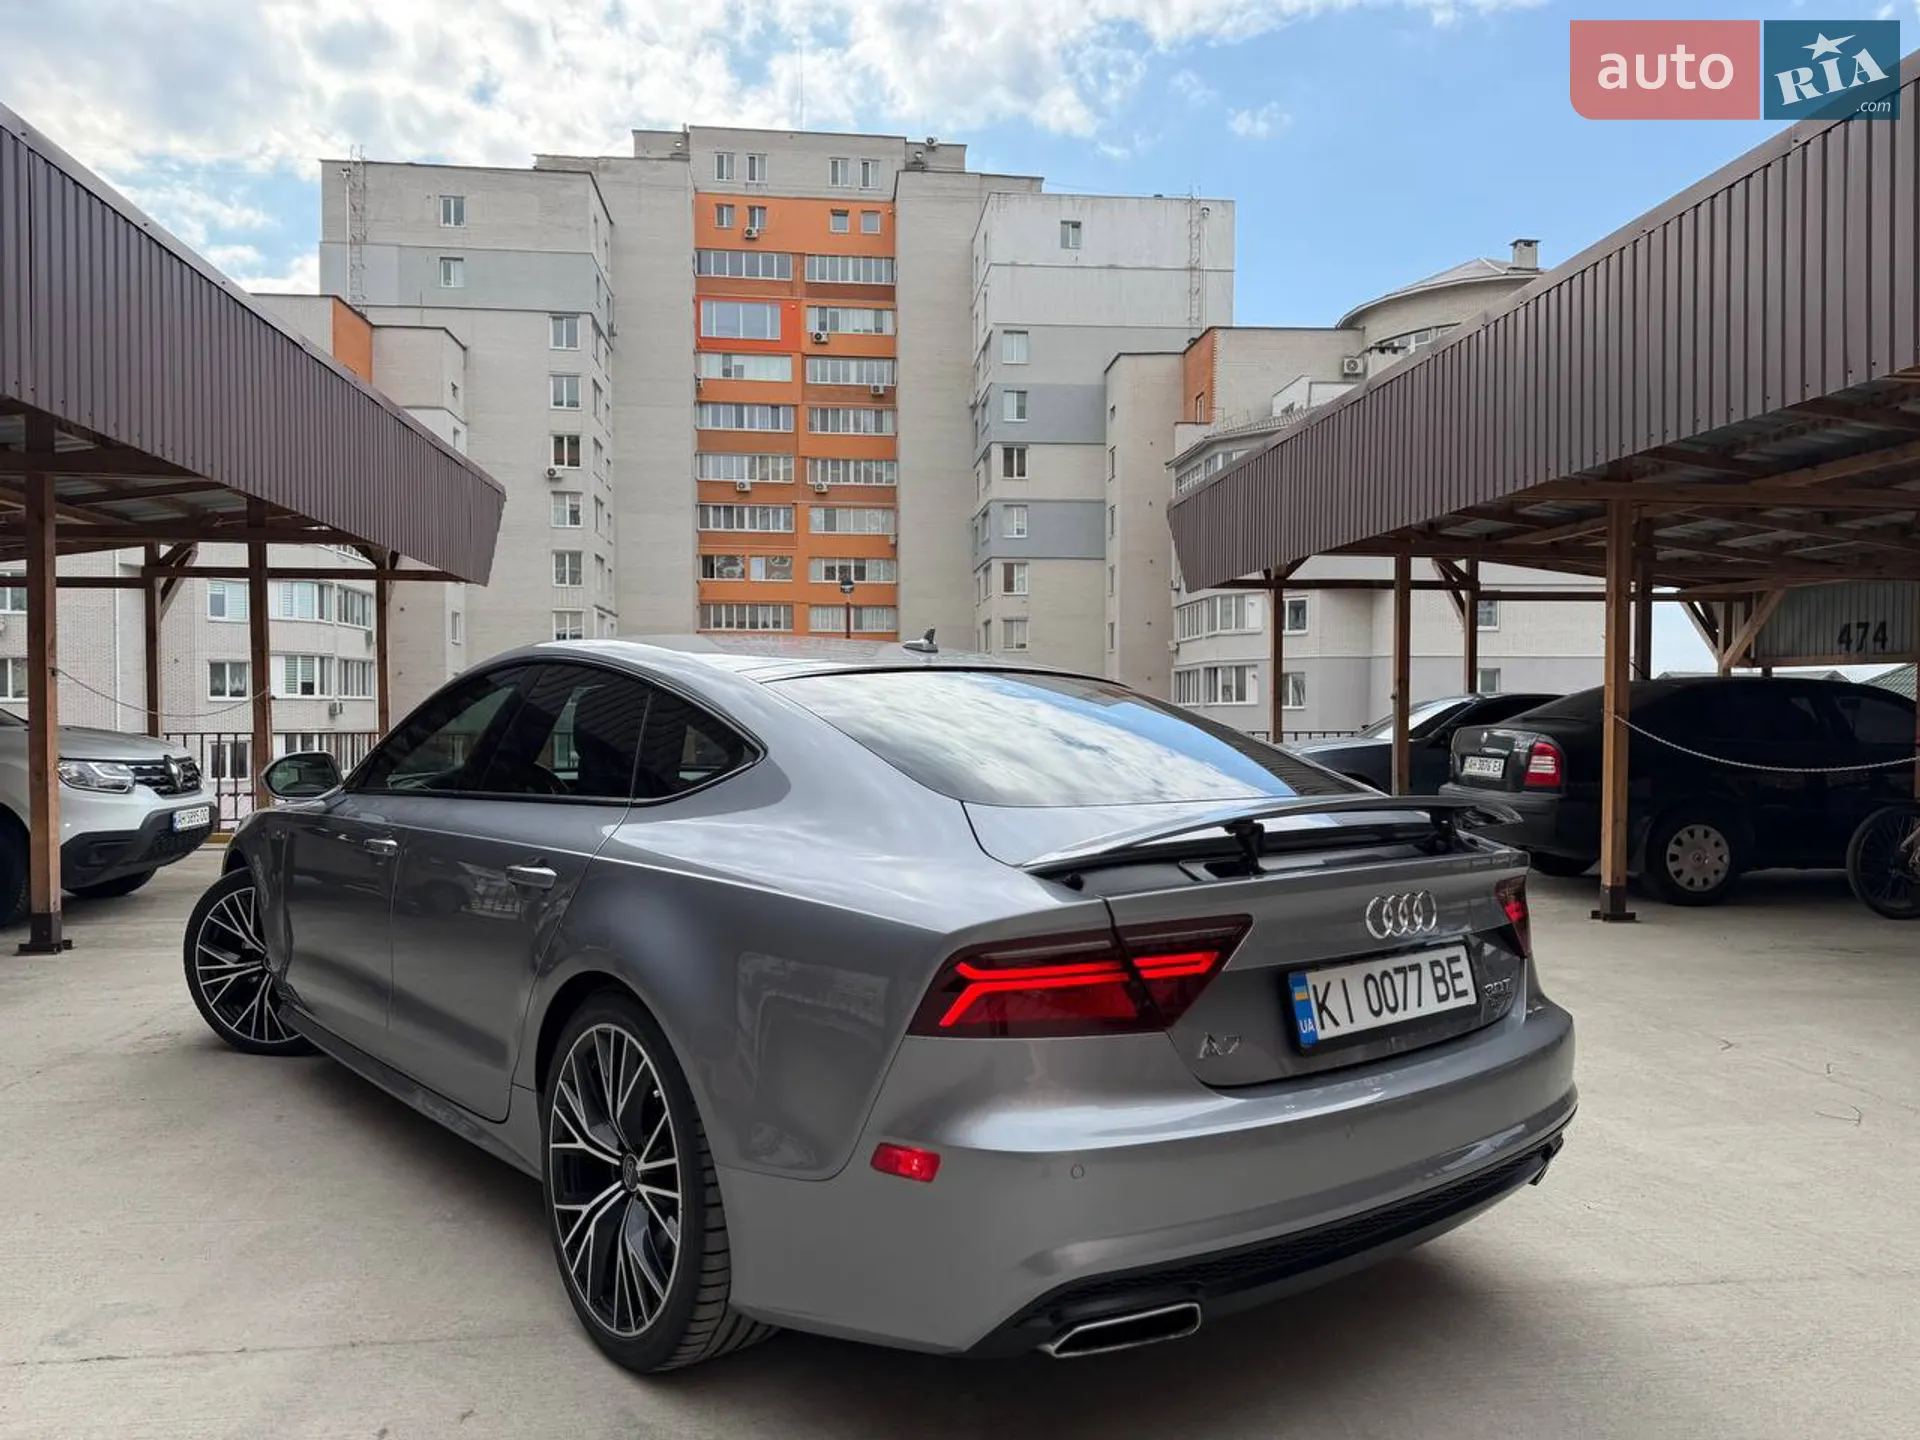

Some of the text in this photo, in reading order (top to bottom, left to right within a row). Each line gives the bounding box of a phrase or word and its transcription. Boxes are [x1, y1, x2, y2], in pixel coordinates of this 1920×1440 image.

[1837, 620, 1888, 652] 474
[1312, 955, 1469, 1030] KI 0077 BE
[1300, 1018, 1316, 1033] UA
[1196, 1031, 1242, 1060] A7
